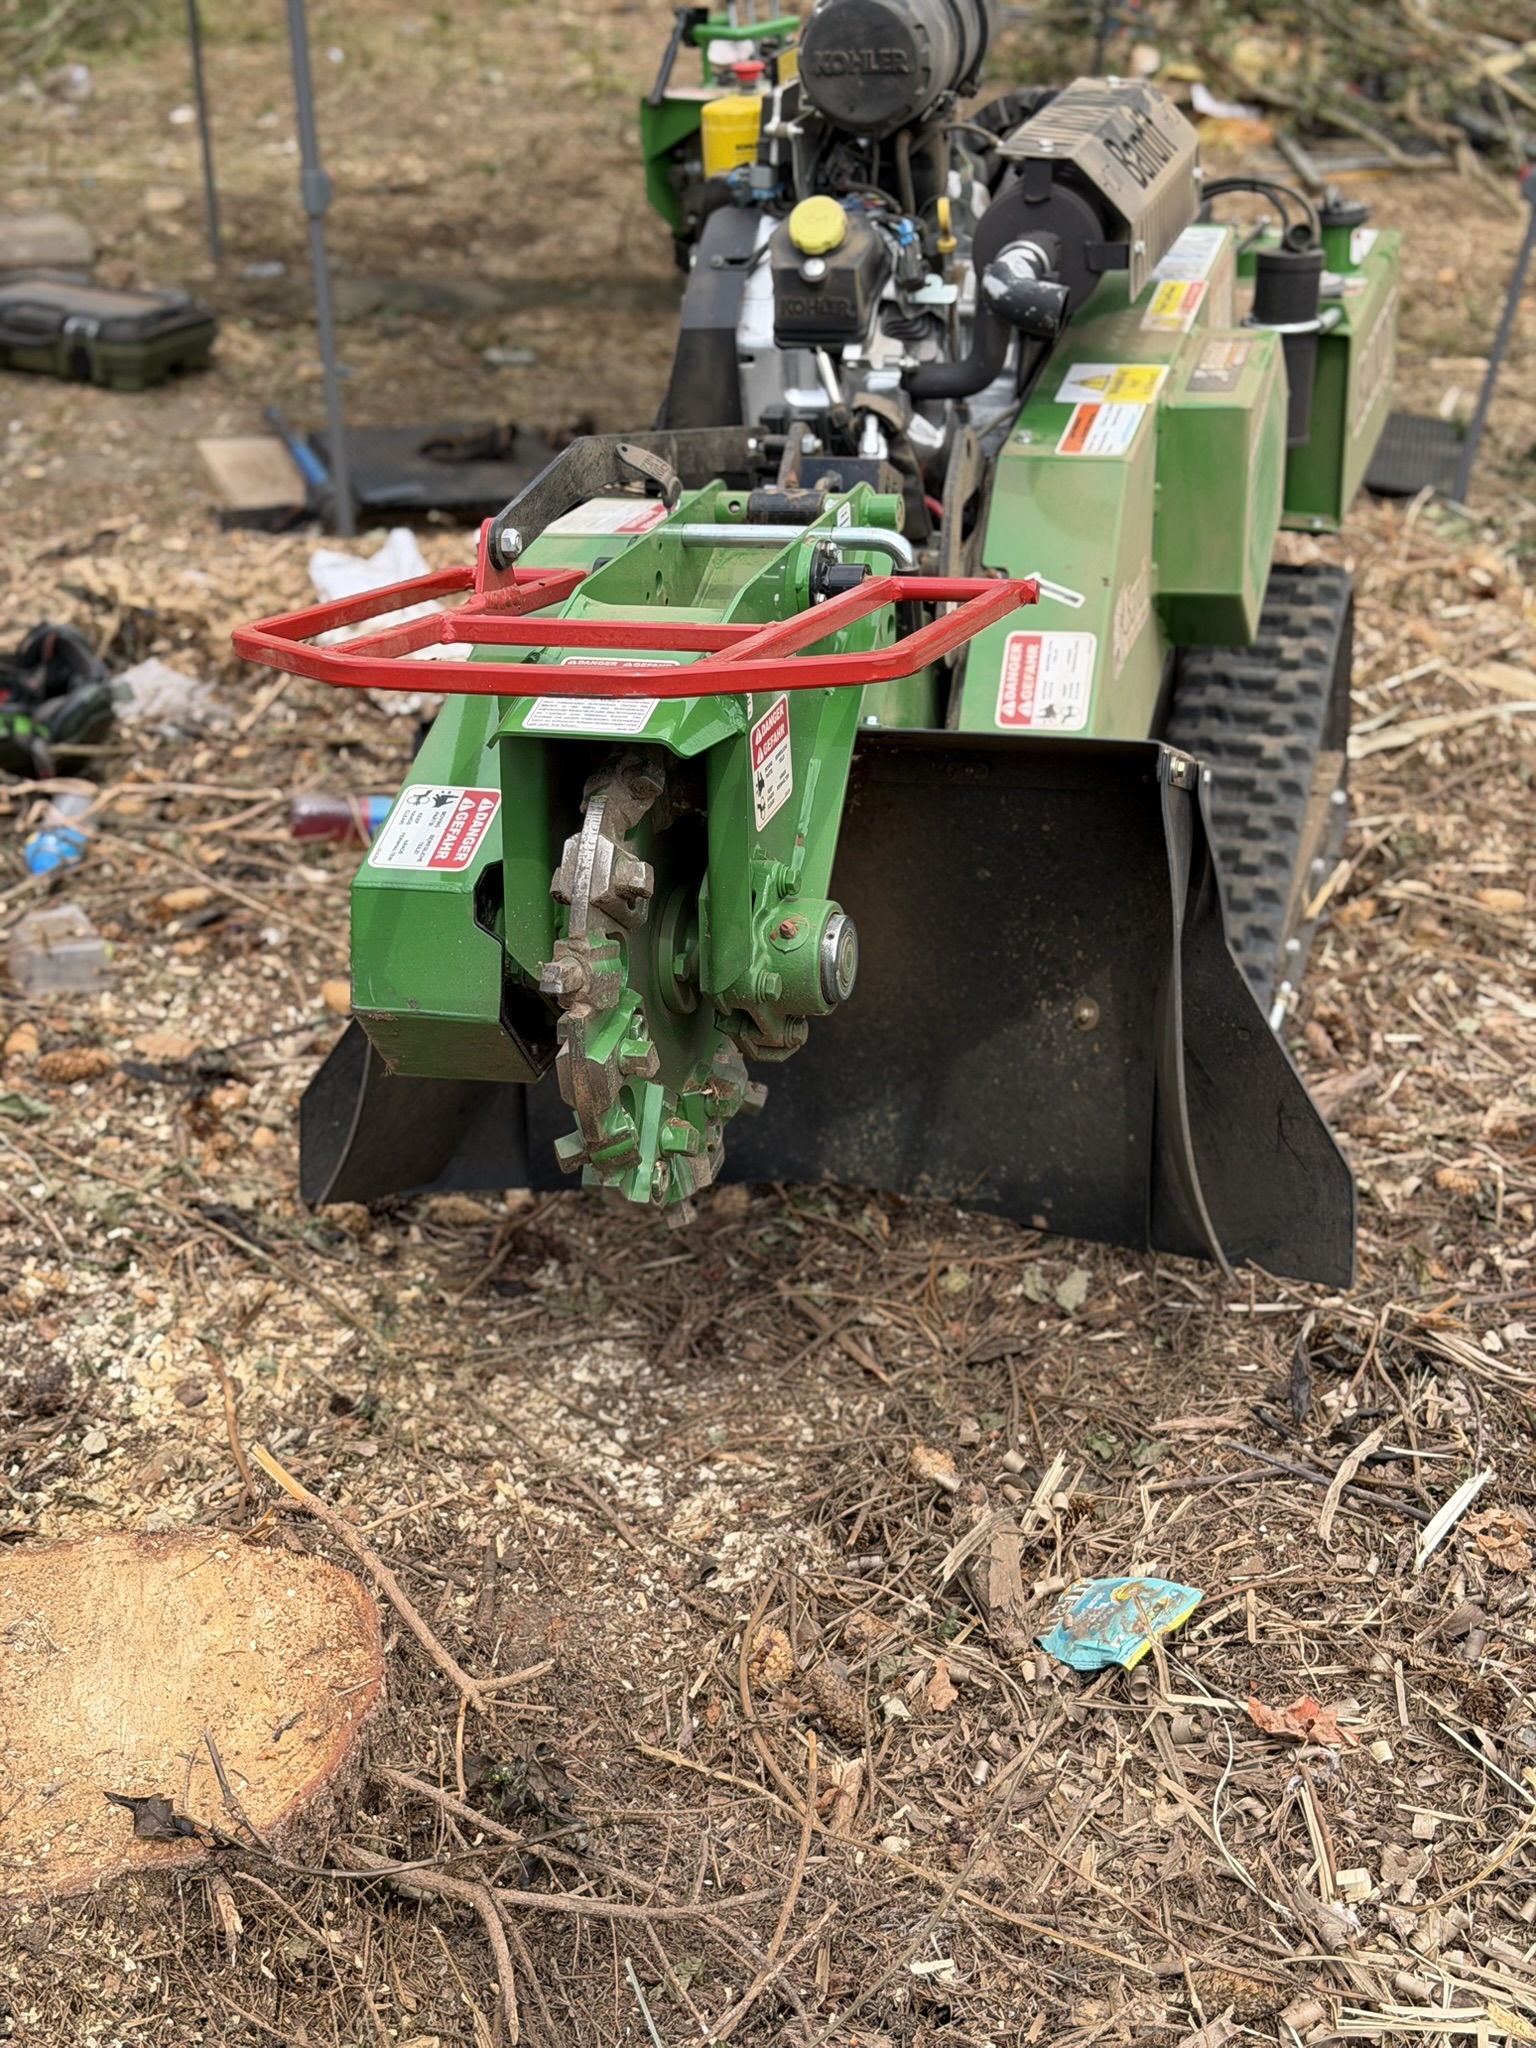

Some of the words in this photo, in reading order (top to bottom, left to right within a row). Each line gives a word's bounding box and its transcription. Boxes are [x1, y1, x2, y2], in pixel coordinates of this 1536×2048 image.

[814, 49, 911, 76] KOHLER
[1103, 107, 1178, 189] Bandit
[780, 299, 851, 318] KOHLER
[1004, 642, 1023, 700] DANGER
[1021, 643, 1040, 700] GEFAHR
[760, 703, 785, 738] DANGER
[763, 722, 786, 757] GEFAHR
[434, 812, 469, 860] GEFAHR
[453, 812, 489, 862] DANGER
